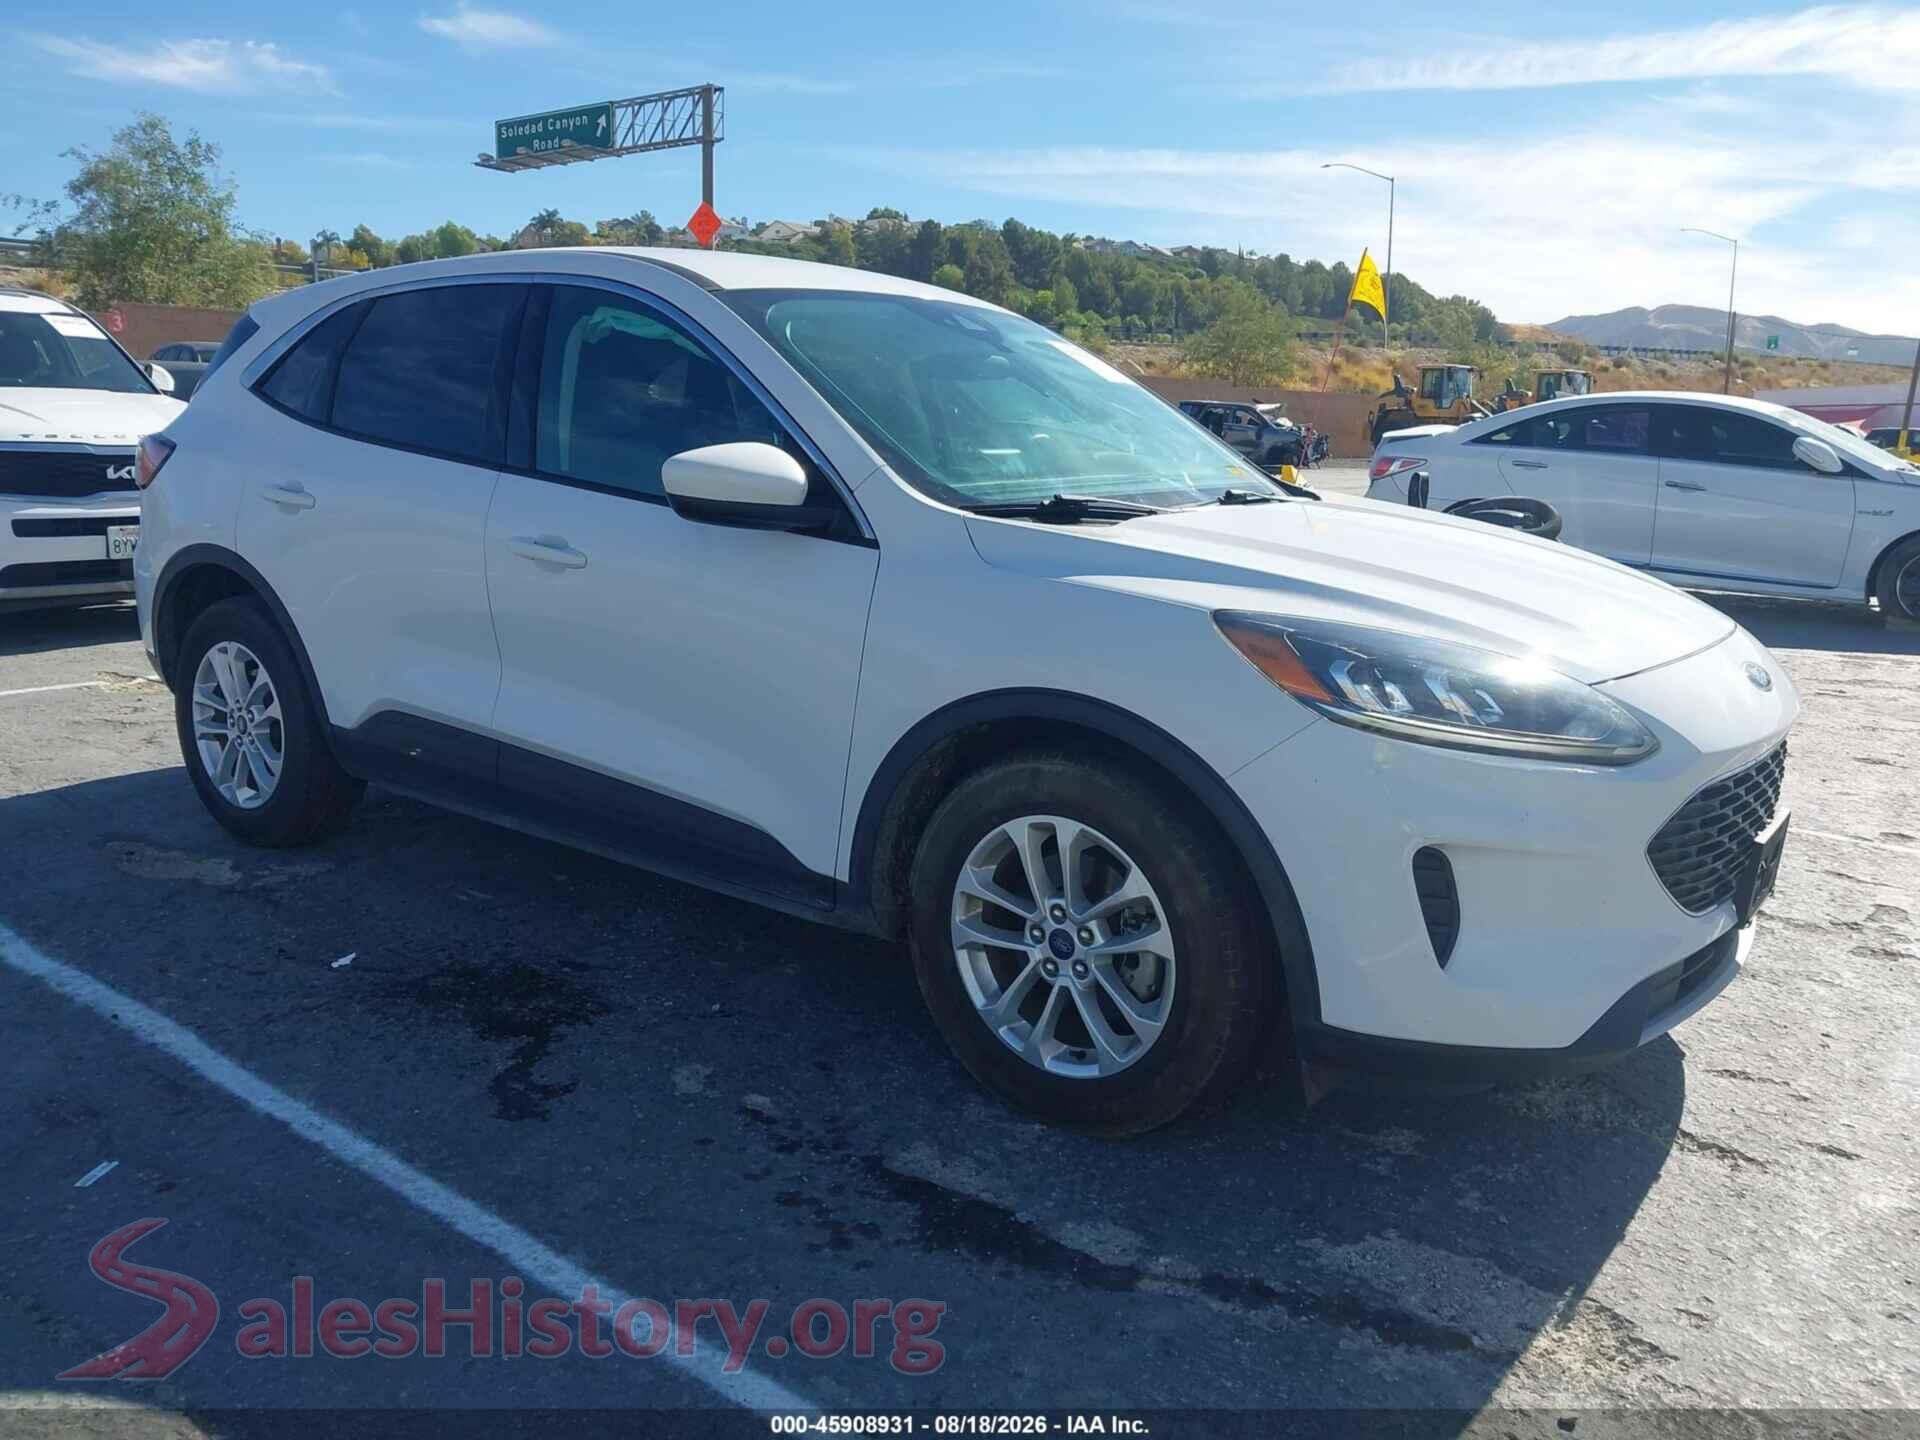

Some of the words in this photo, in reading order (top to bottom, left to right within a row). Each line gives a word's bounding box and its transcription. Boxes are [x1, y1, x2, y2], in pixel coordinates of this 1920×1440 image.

[501, 121, 543, 138] Soledad
[547, 115, 588, 131] Canyon
[532, 136, 559, 152] Road
